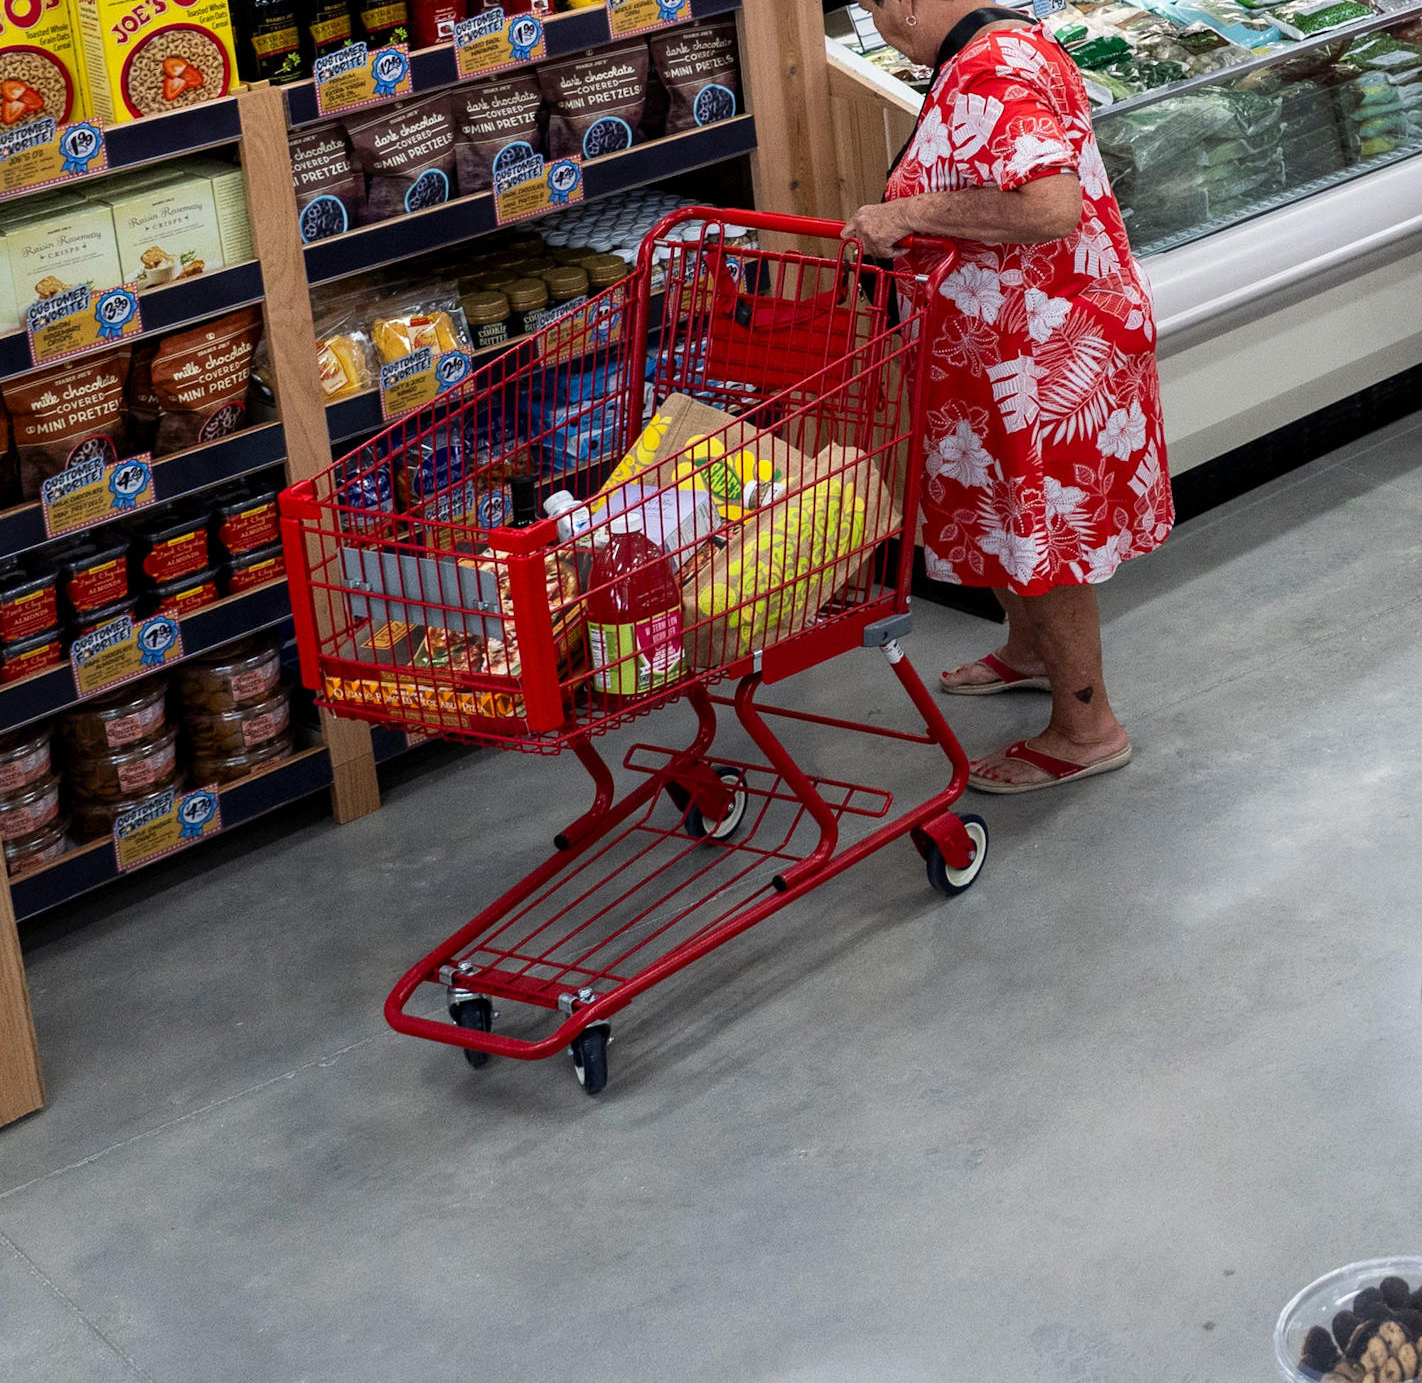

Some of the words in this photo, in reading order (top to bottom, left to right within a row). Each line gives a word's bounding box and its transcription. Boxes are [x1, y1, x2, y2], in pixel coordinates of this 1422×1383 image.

[186, 7, 208, 18] Toasted
[207, 1, 228, 12] Whole
[198, 13, 214, 25] Grain
[213, 10, 229, 21] Oats
[25, 28, 51, 42] Toasted
[50, 23, 70, 34] Whole
[210, 19, 230, 30] Cereal
[456, 9, 502, 36] CUSTOMER
[39, 34, 57, 47] Grain
[56, 31, 71, 43] Oats
[52, 41, 72, 53] Cereal
[665, 43, 692, 58] dark
[692, 37, 734, 54] chocolate
[316, 42, 366, 71] CUSTOMER
[671, 65, 694, 79] MINI
[694, 54, 735, 73] PRETZELS
[559, 75, 585, 90] dark
[585, 64, 637, 84] chocolate
[576, 78, 620, 95] COVERED
[466, 98, 490, 115] dark
[491, 91, 539, 108] chocolate
[564, 95, 596, 111] MINI
[596, 84, 644, 106] PRETZELS
[468, 120, 496, 137] MINI
[496, 112, 538, 131] PRETZE
[485, 105, 525, 120] COVERED
[374, 127, 399, 149] dark
[399, 112, 446, 138] chocolate
[396, 129, 434, 151] COVERED
[382, 151, 408, 170] MINI
[495, 156, 541, 183] CUSTOMER
[128, 213, 160, 229] Raisin
[159, 202, 204, 220] Rosemary
[22, 239, 55, 258] Raisin
[55, 231, 103, 249] Rosemary
[47, 245, 81, 260] CRISPS
[29, 286, 90, 320] CUSTOMER
[478, 325, 508, 339] COOKIE
[173, 361, 202, 382] milk
[204, 341, 253, 370] chocolate
[198, 361, 241, 385] COVERED
[381, 349, 432, 376] CUSTOMER
[30, 390, 60, 412] milk
[62, 372, 119, 401] chocolate
[177, 387, 206, 404] MINI
[208, 369, 251, 395] PRETZE
[55, 391, 106, 415] COVERED
[36, 417, 67, 436] MINI
[44, 458, 103, 492] CUSTOMER
[73, 617, 131, 654] CUSTOMER
[116, 794, 172, 828] CUSTOMER
